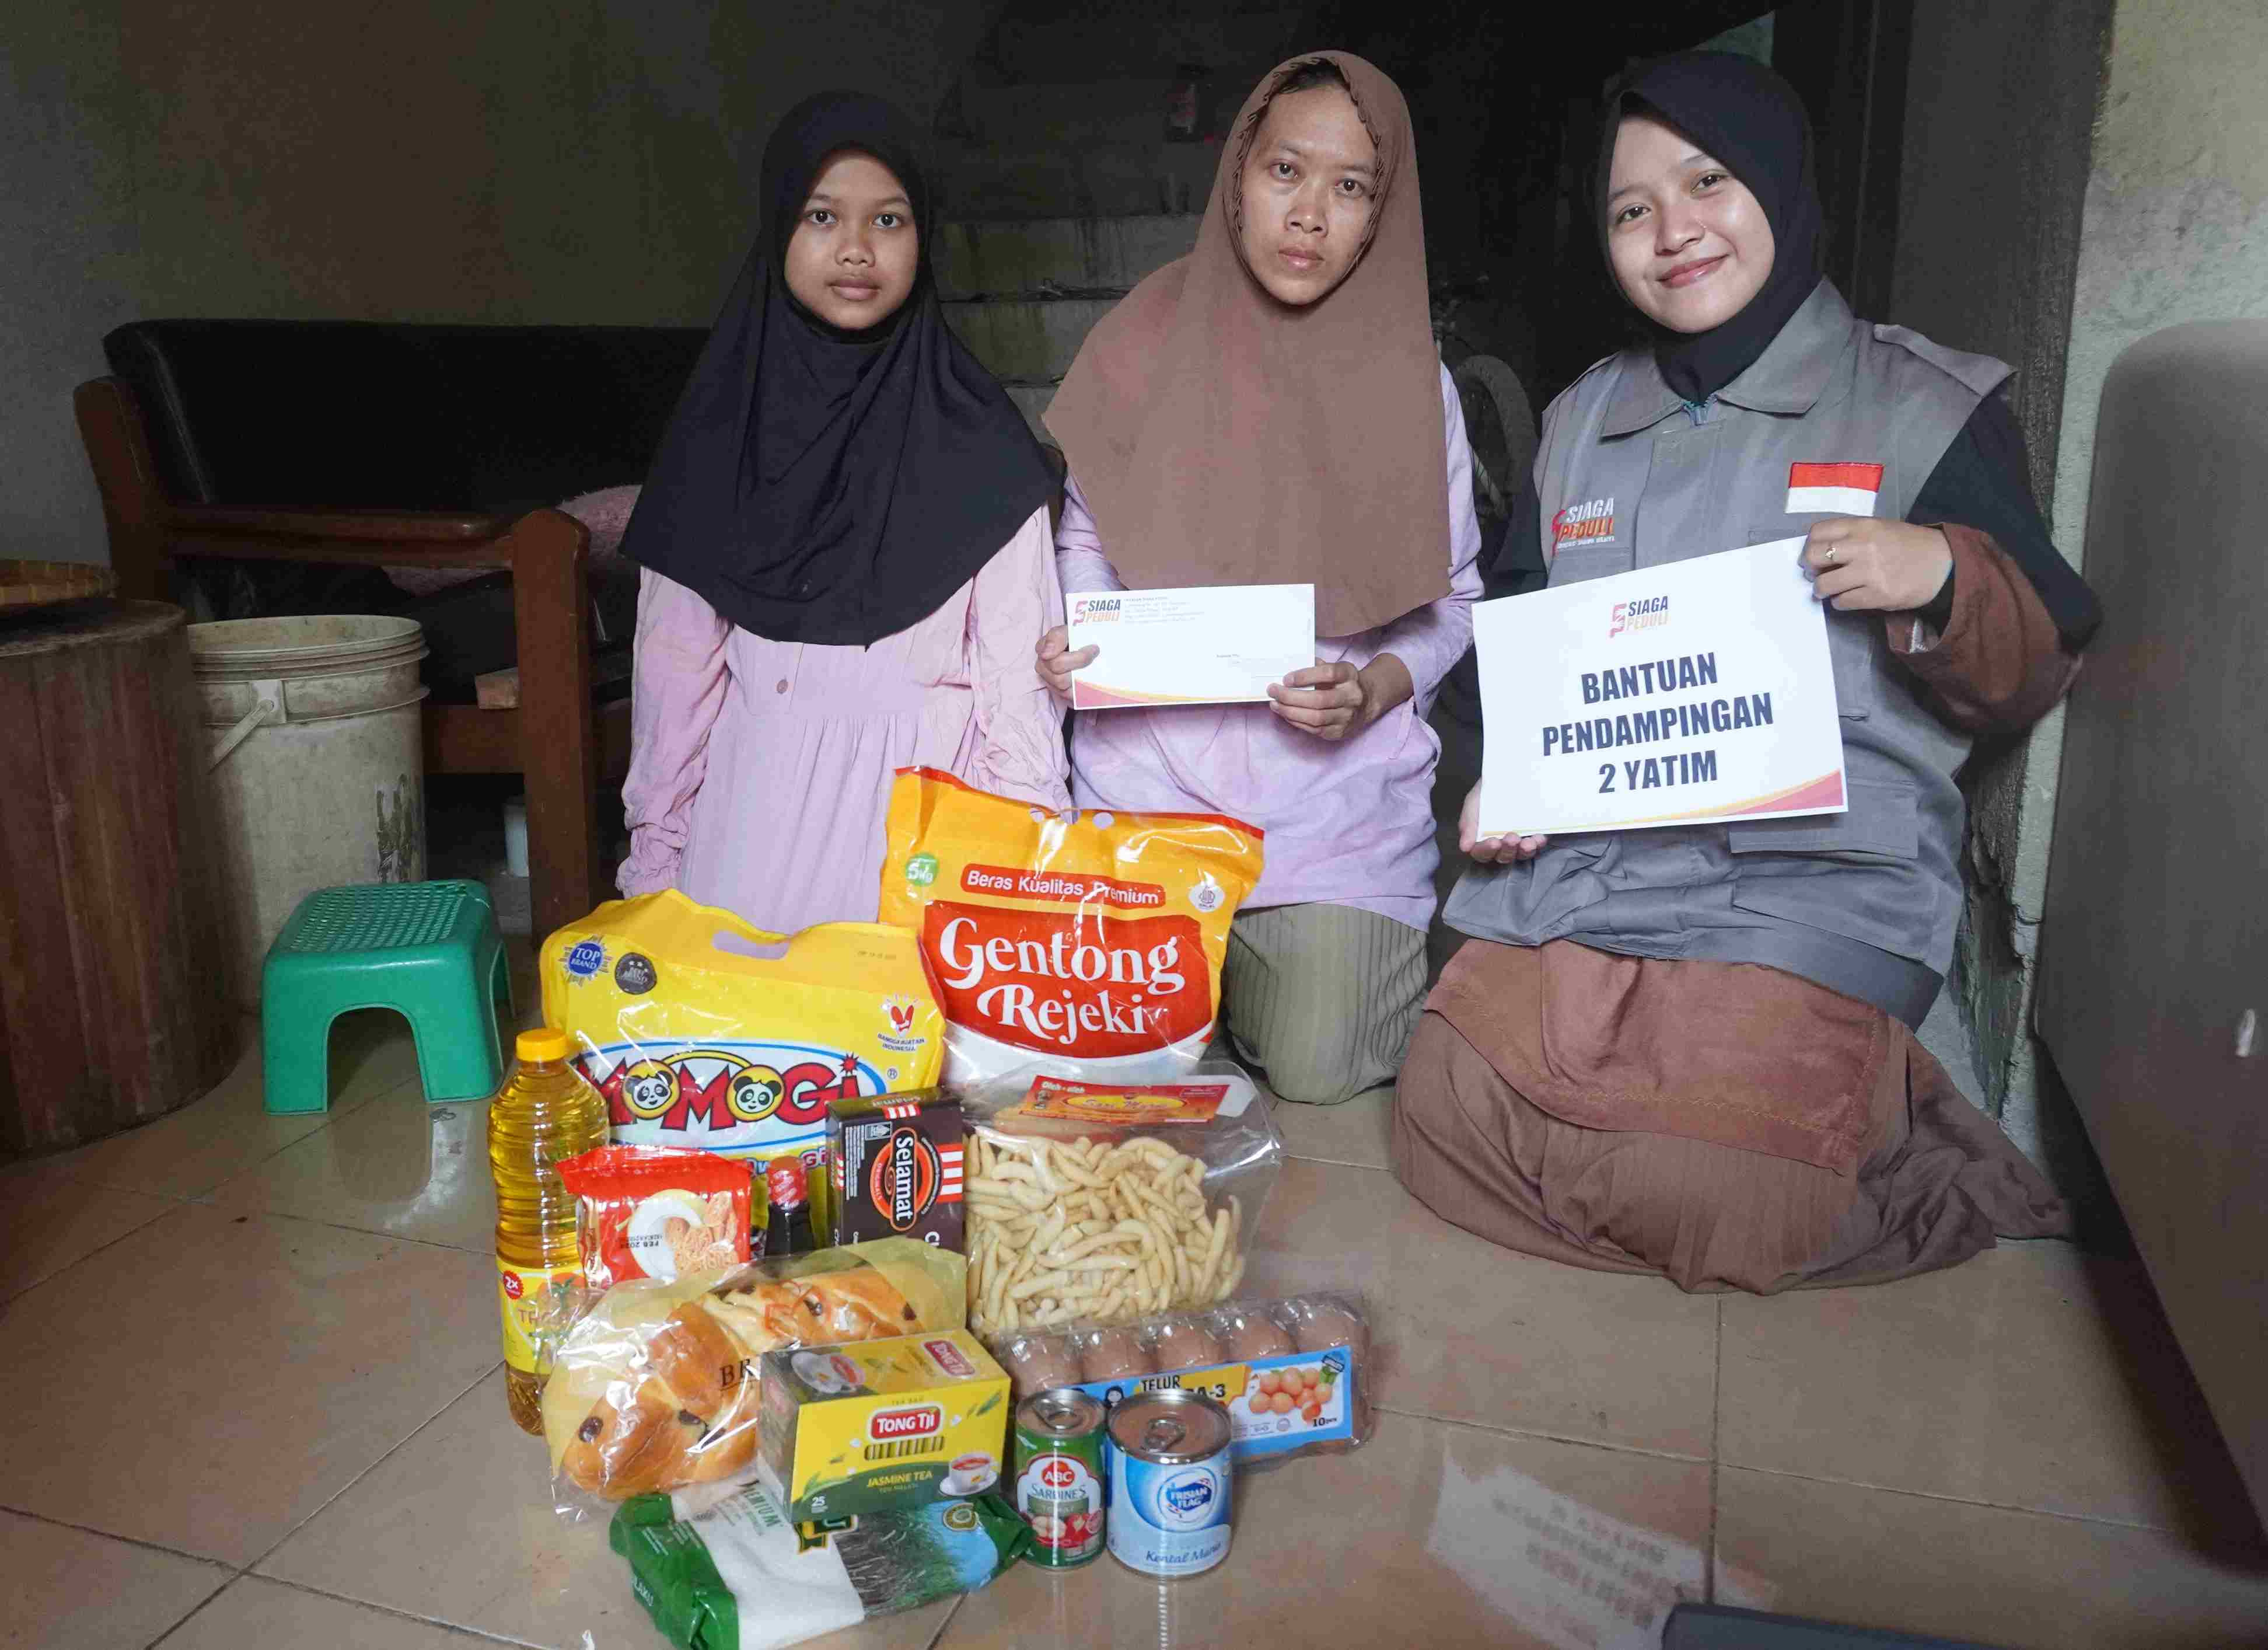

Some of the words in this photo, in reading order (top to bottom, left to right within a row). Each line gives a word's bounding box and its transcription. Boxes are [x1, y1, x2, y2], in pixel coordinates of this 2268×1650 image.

[1567, 498, 1614, 523] SIAGA
[1558, 517, 1614, 542] PEDULI
[1088, 599, 1121, 612] SIAGA
[1627, 595, 1669, 617] SIAGA
[1086, 611, 1120, 622] PEDULI
[1626, 613, 1668, 631] PEDULI
[1581, 652, 1718, 704] BANTUAN
[1542, 692, 1774, 756] PENDAMPINGAN
[1598, 763, 1616, 793] 2
[1623, 750, 1718, 789] YATIM
[967, 870, 1013, 891] Beras
[1018, 875, 1084, 897] Kualitas
[1092, 880, 1159, 904] Premium
[576, 947, 600, 961] TOP
[939, 917, 1186, 996] Gentong
[571, 958, 597, 969] BRAND
[976, 983, 1148, 1045] Rejeki
[882, 1043, 916, 1051] INDONESIA
[896, 1136, 914, 1221] Selamat
[1141, 1375, 1181, 1392] TELUR
[876, 1417, 915, 1433] TONG
[1313, 1417, 1326, 1427] 10
[867, 1473, 912, 1488] JASMINE
[913, 1470, 933, 1481] TEA
[1044, 1471, 1074, 1483] ABC
[1031, 1484, 1087, 1499] SARDINES
[1170, 1487, 1208, 1501] FRISIAN
[812, 1495, 826, 1506] 25
[1178, 1498, 1203, 1510] FLAG
[1146, 1550, 1190, 1564] Kental
